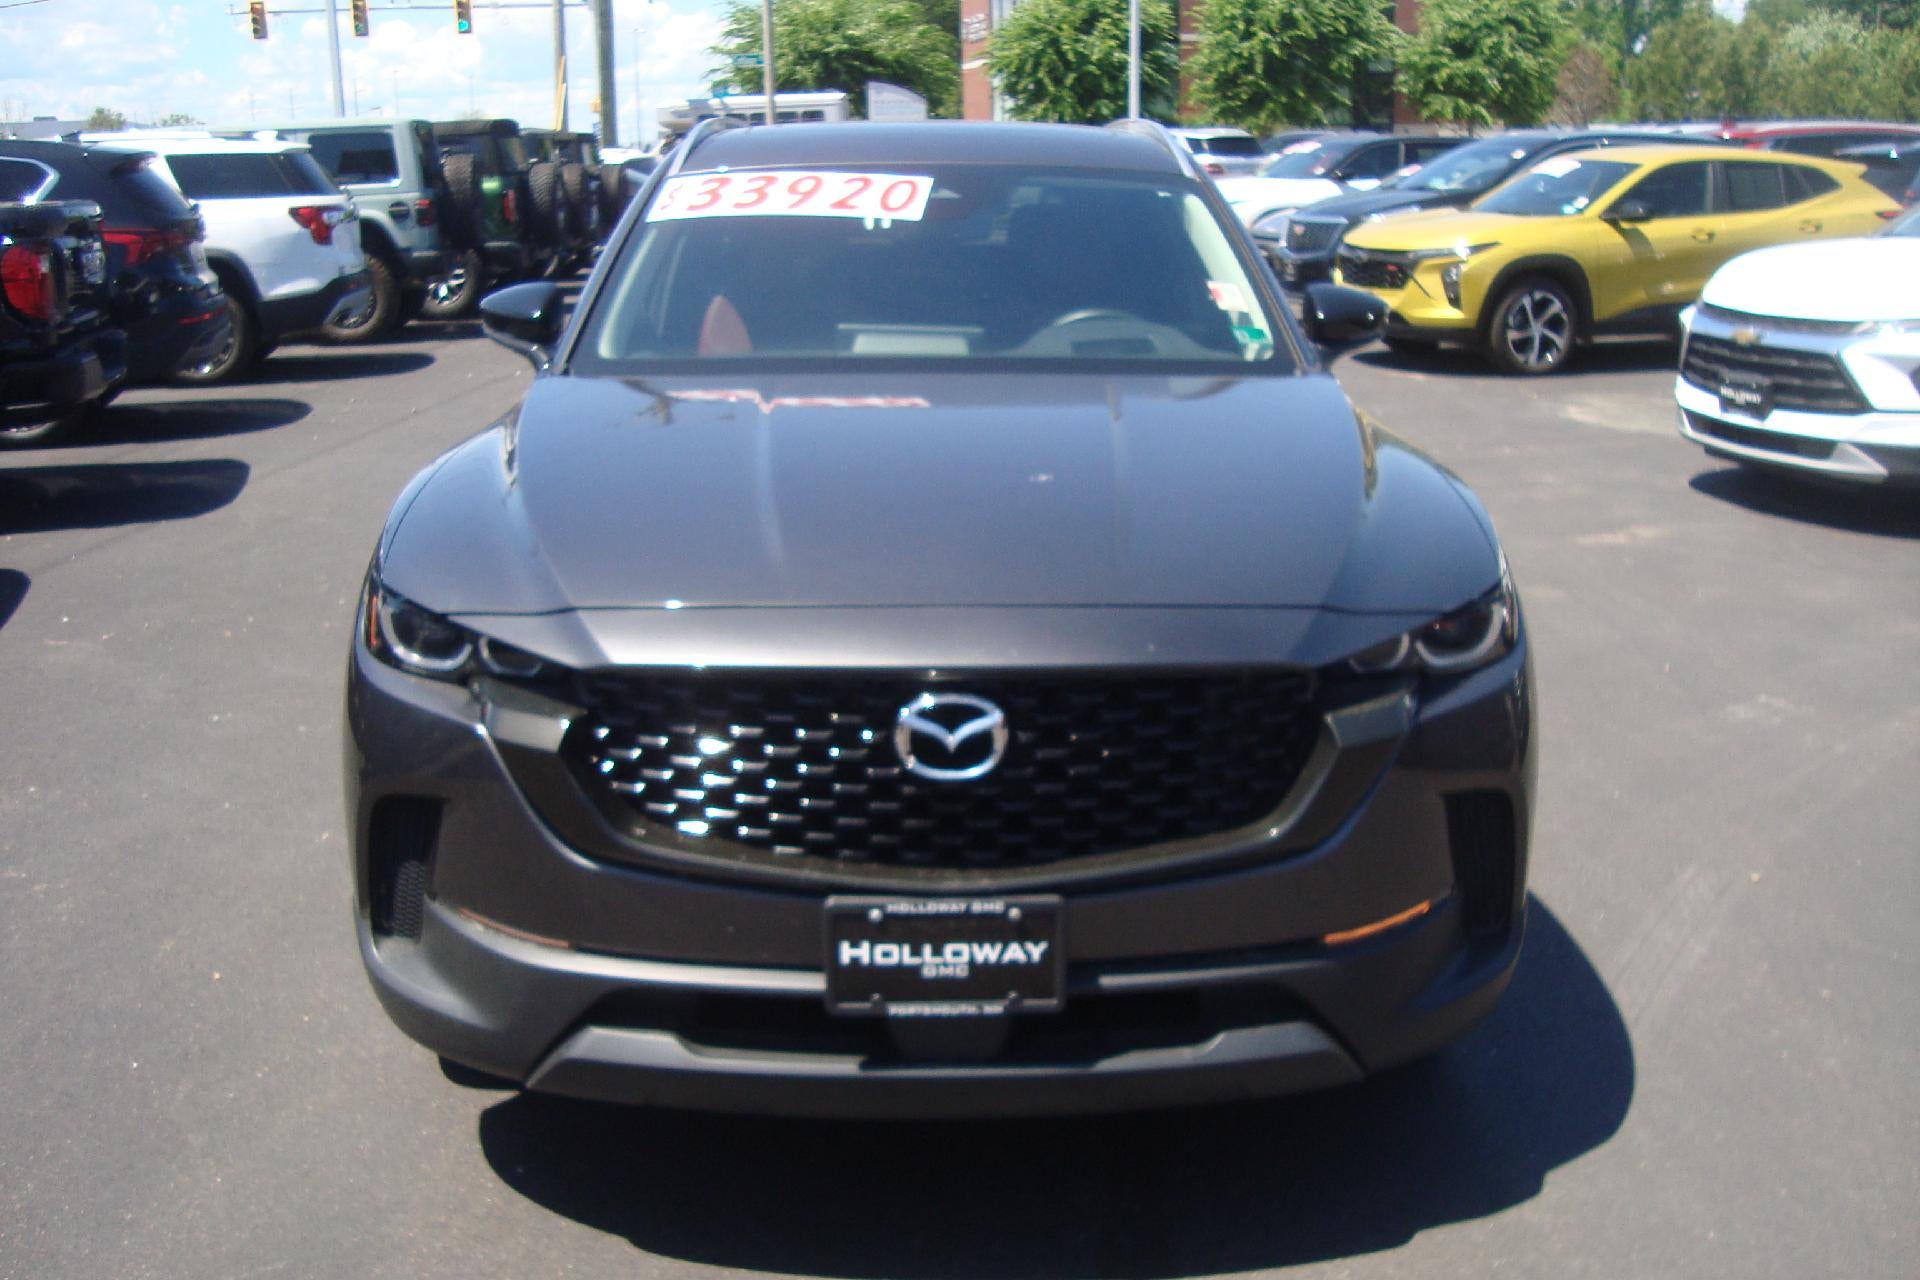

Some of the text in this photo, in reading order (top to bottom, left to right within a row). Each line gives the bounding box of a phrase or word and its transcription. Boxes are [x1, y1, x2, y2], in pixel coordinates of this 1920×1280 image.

[887, 902, 966, 914] HOLLOWAY
[839, 940, 1048, 966] HOLLOWAY
[922, 963, 969, 978] GMC
